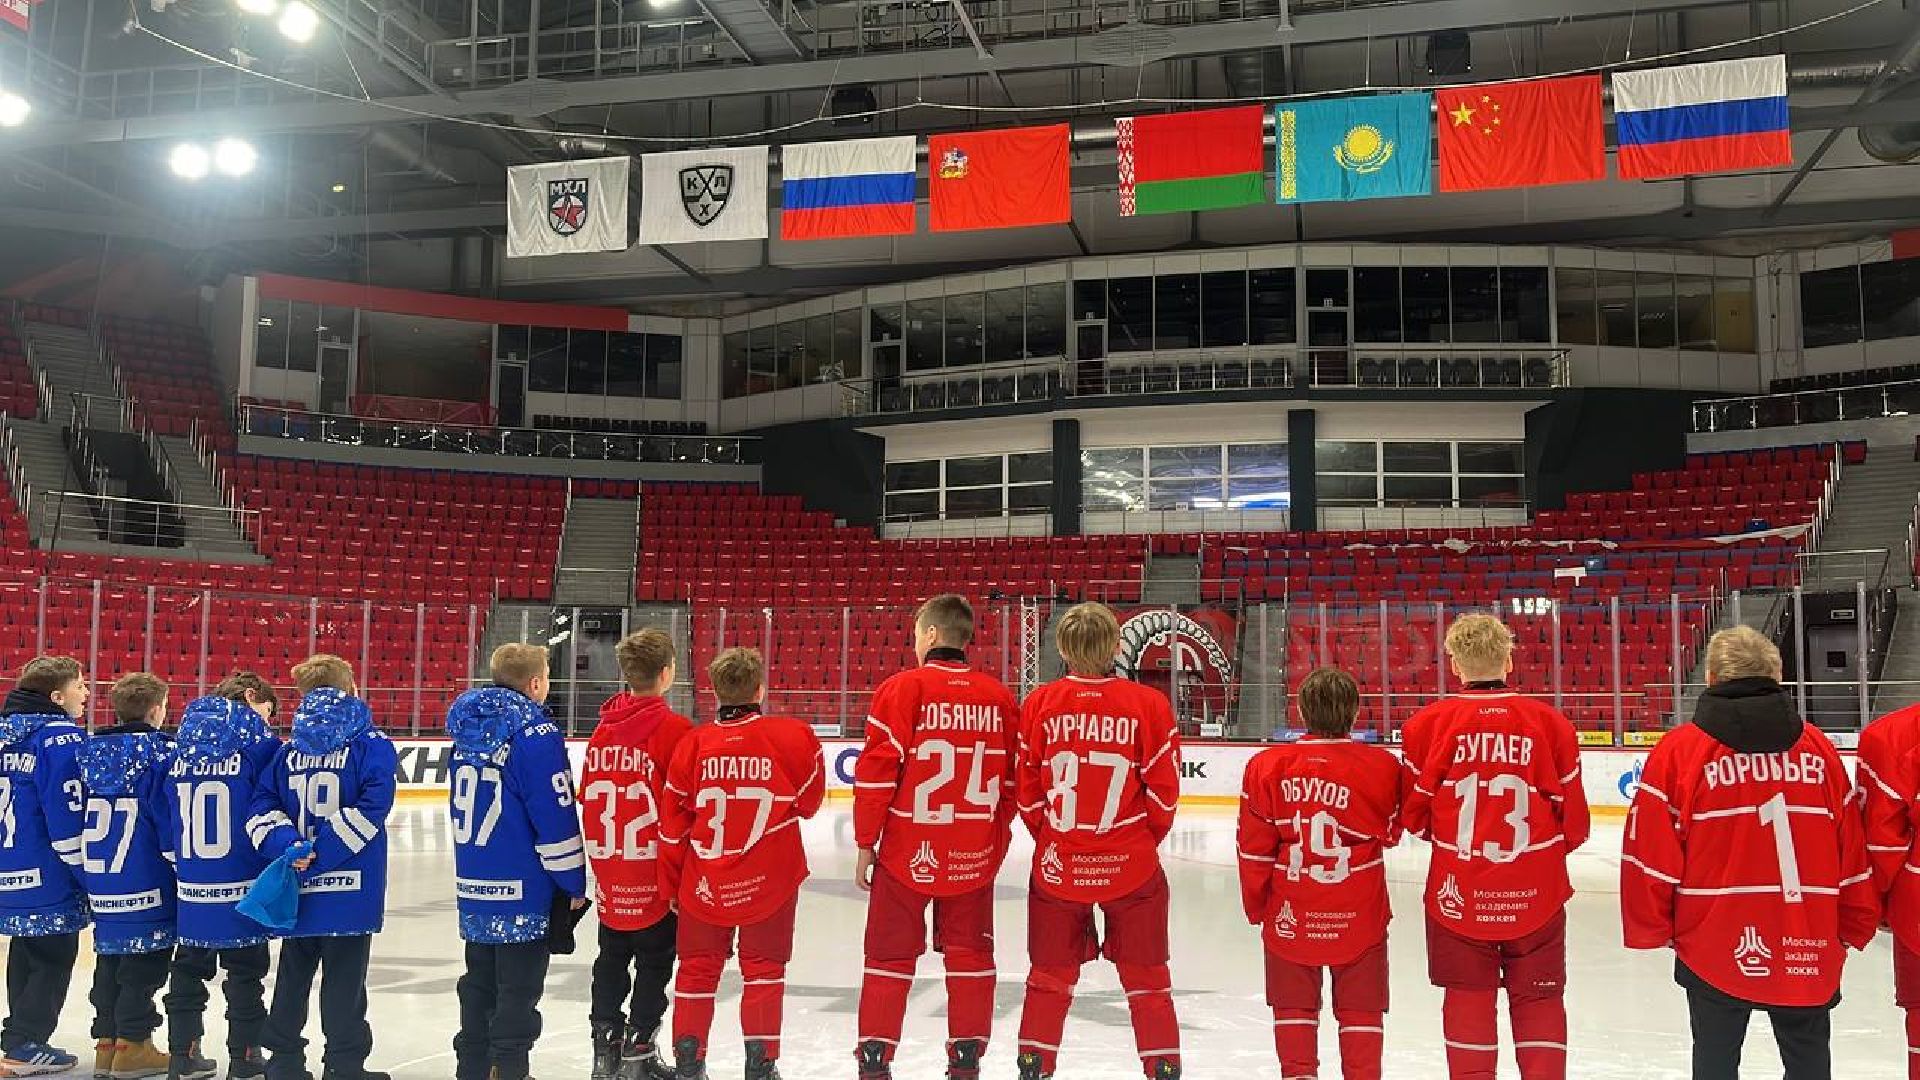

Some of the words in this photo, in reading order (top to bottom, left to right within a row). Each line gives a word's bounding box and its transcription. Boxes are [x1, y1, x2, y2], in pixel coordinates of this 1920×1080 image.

[551, 181, 586, 194] МХЛ
[912, 738, 1001, 824] 24
[1454, 732, 1533, 766] БУГАЕВ
[176, 780, 232, 859] 10
[453, 765, 503, 847] 97
[551, 769, 573, 808] 9
[582, 780, 658, 861] 32
[690, 786, 774, 860] 37
[1046, 750, 1131, 835] 87
[1281, 777, 1351, 809] ОБУХОВ
[1454, 771, 1531, 864] 13
[81, 797, 139, 874] 27
[1286, 809, 1352, 884] 19
[1758, 792, 1804, 904] 1
[1473, 888, 1538, 899] Московская
[1475, 902, 1530, 911] академия
[1475, 914, 1517, 923] хоккея
